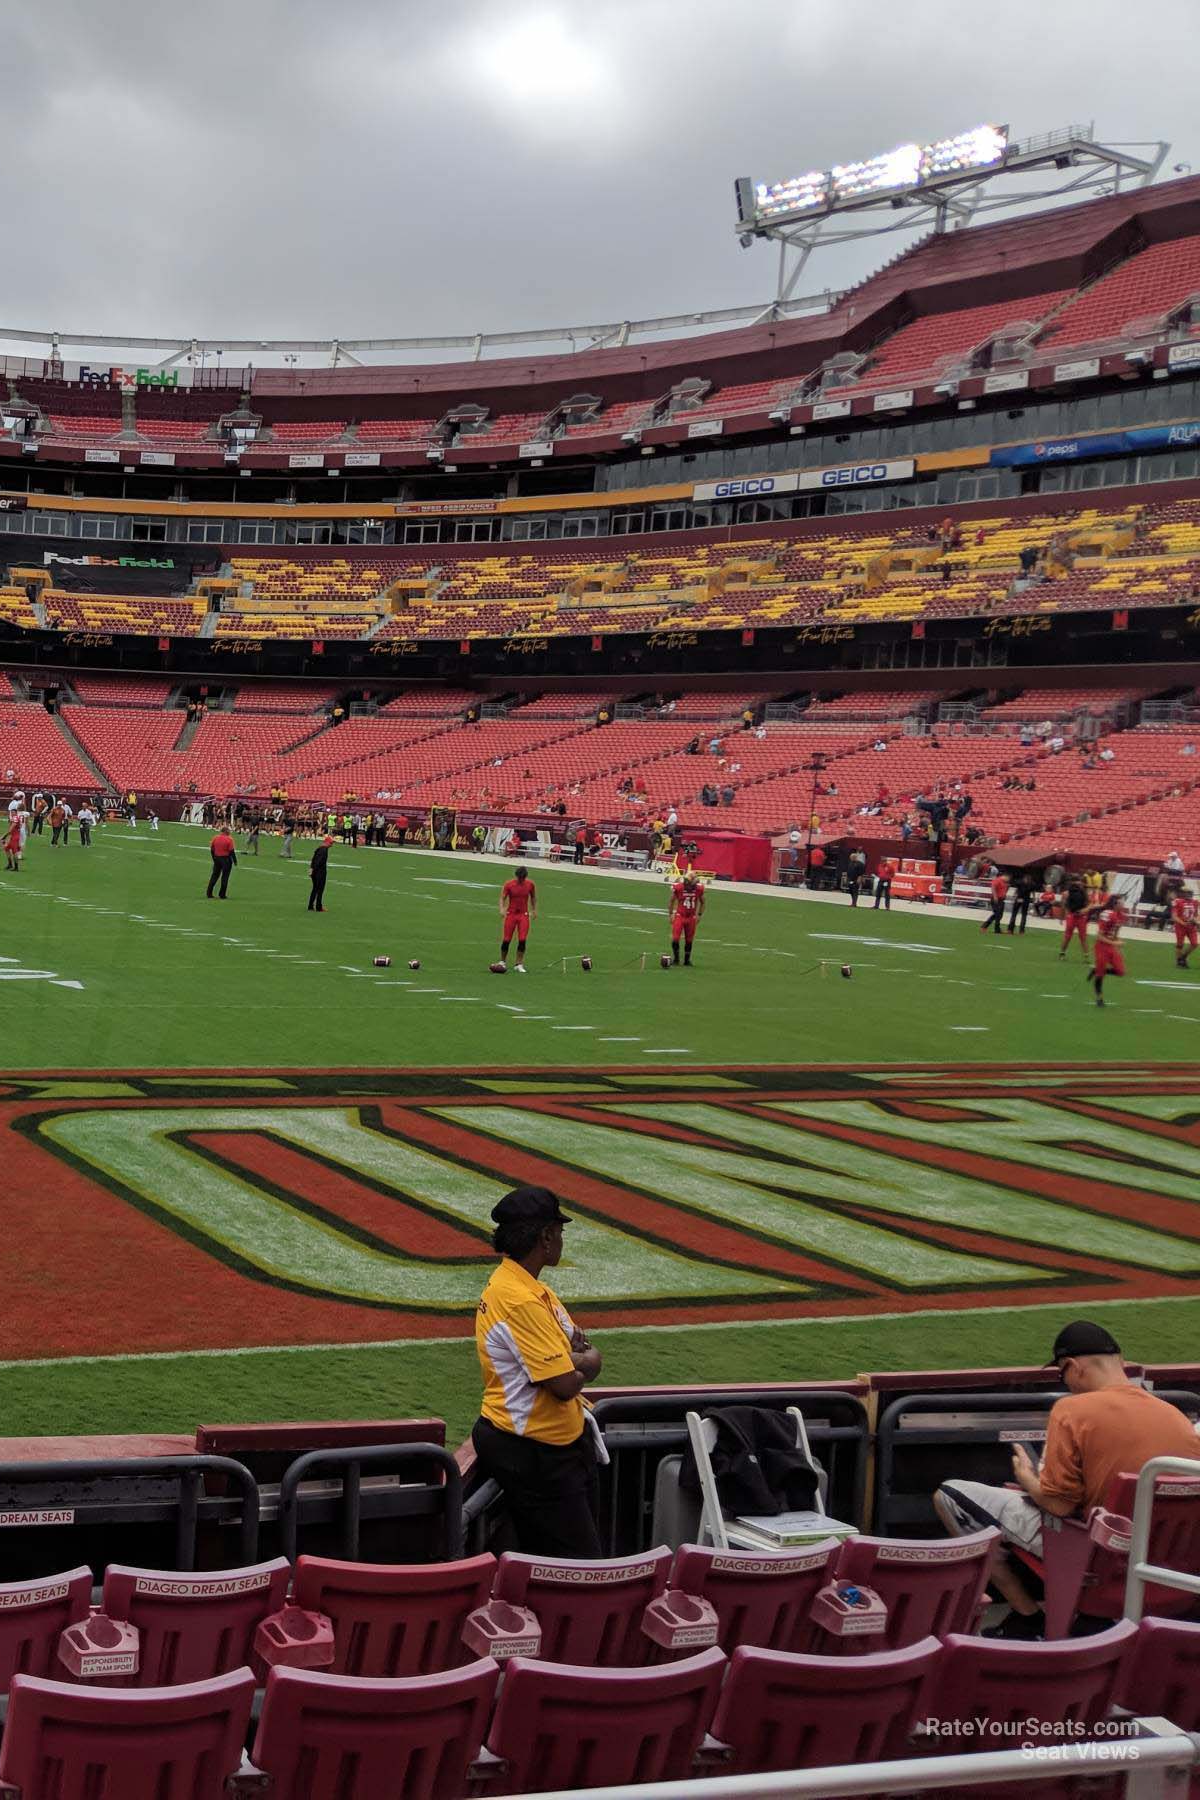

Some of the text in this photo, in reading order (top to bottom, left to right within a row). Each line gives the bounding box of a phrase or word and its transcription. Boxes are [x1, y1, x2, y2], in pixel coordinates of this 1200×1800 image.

[79, 365, 178, 388] FedExField
[822, 465, 887, 486] GEICO
[715, 478, 775, 497] GEICO
[44, 551, 175, 569] FedExField
[0, 1513, 39, 1524] DREAM
[41, 1511, 72, 1523] SEATS
[880, 1547, 926, 1560] DIAGEO
[928, 1548, 965, 1561] DREAM
[714, 1557, 761, 1572] DIAGEO
[763, 1559, 801, 1573] DREAM
[533, 1567, 581, 1580] DIAGEO
[584, 1570, 626, 1582] DREAM
[34, 1584, 68, 1601] SEATS
[138, 1574, 269, 1595] DIAGEO DREAM SEATS
[83, 1656, 133, 1665] RESPONSIBILITY
